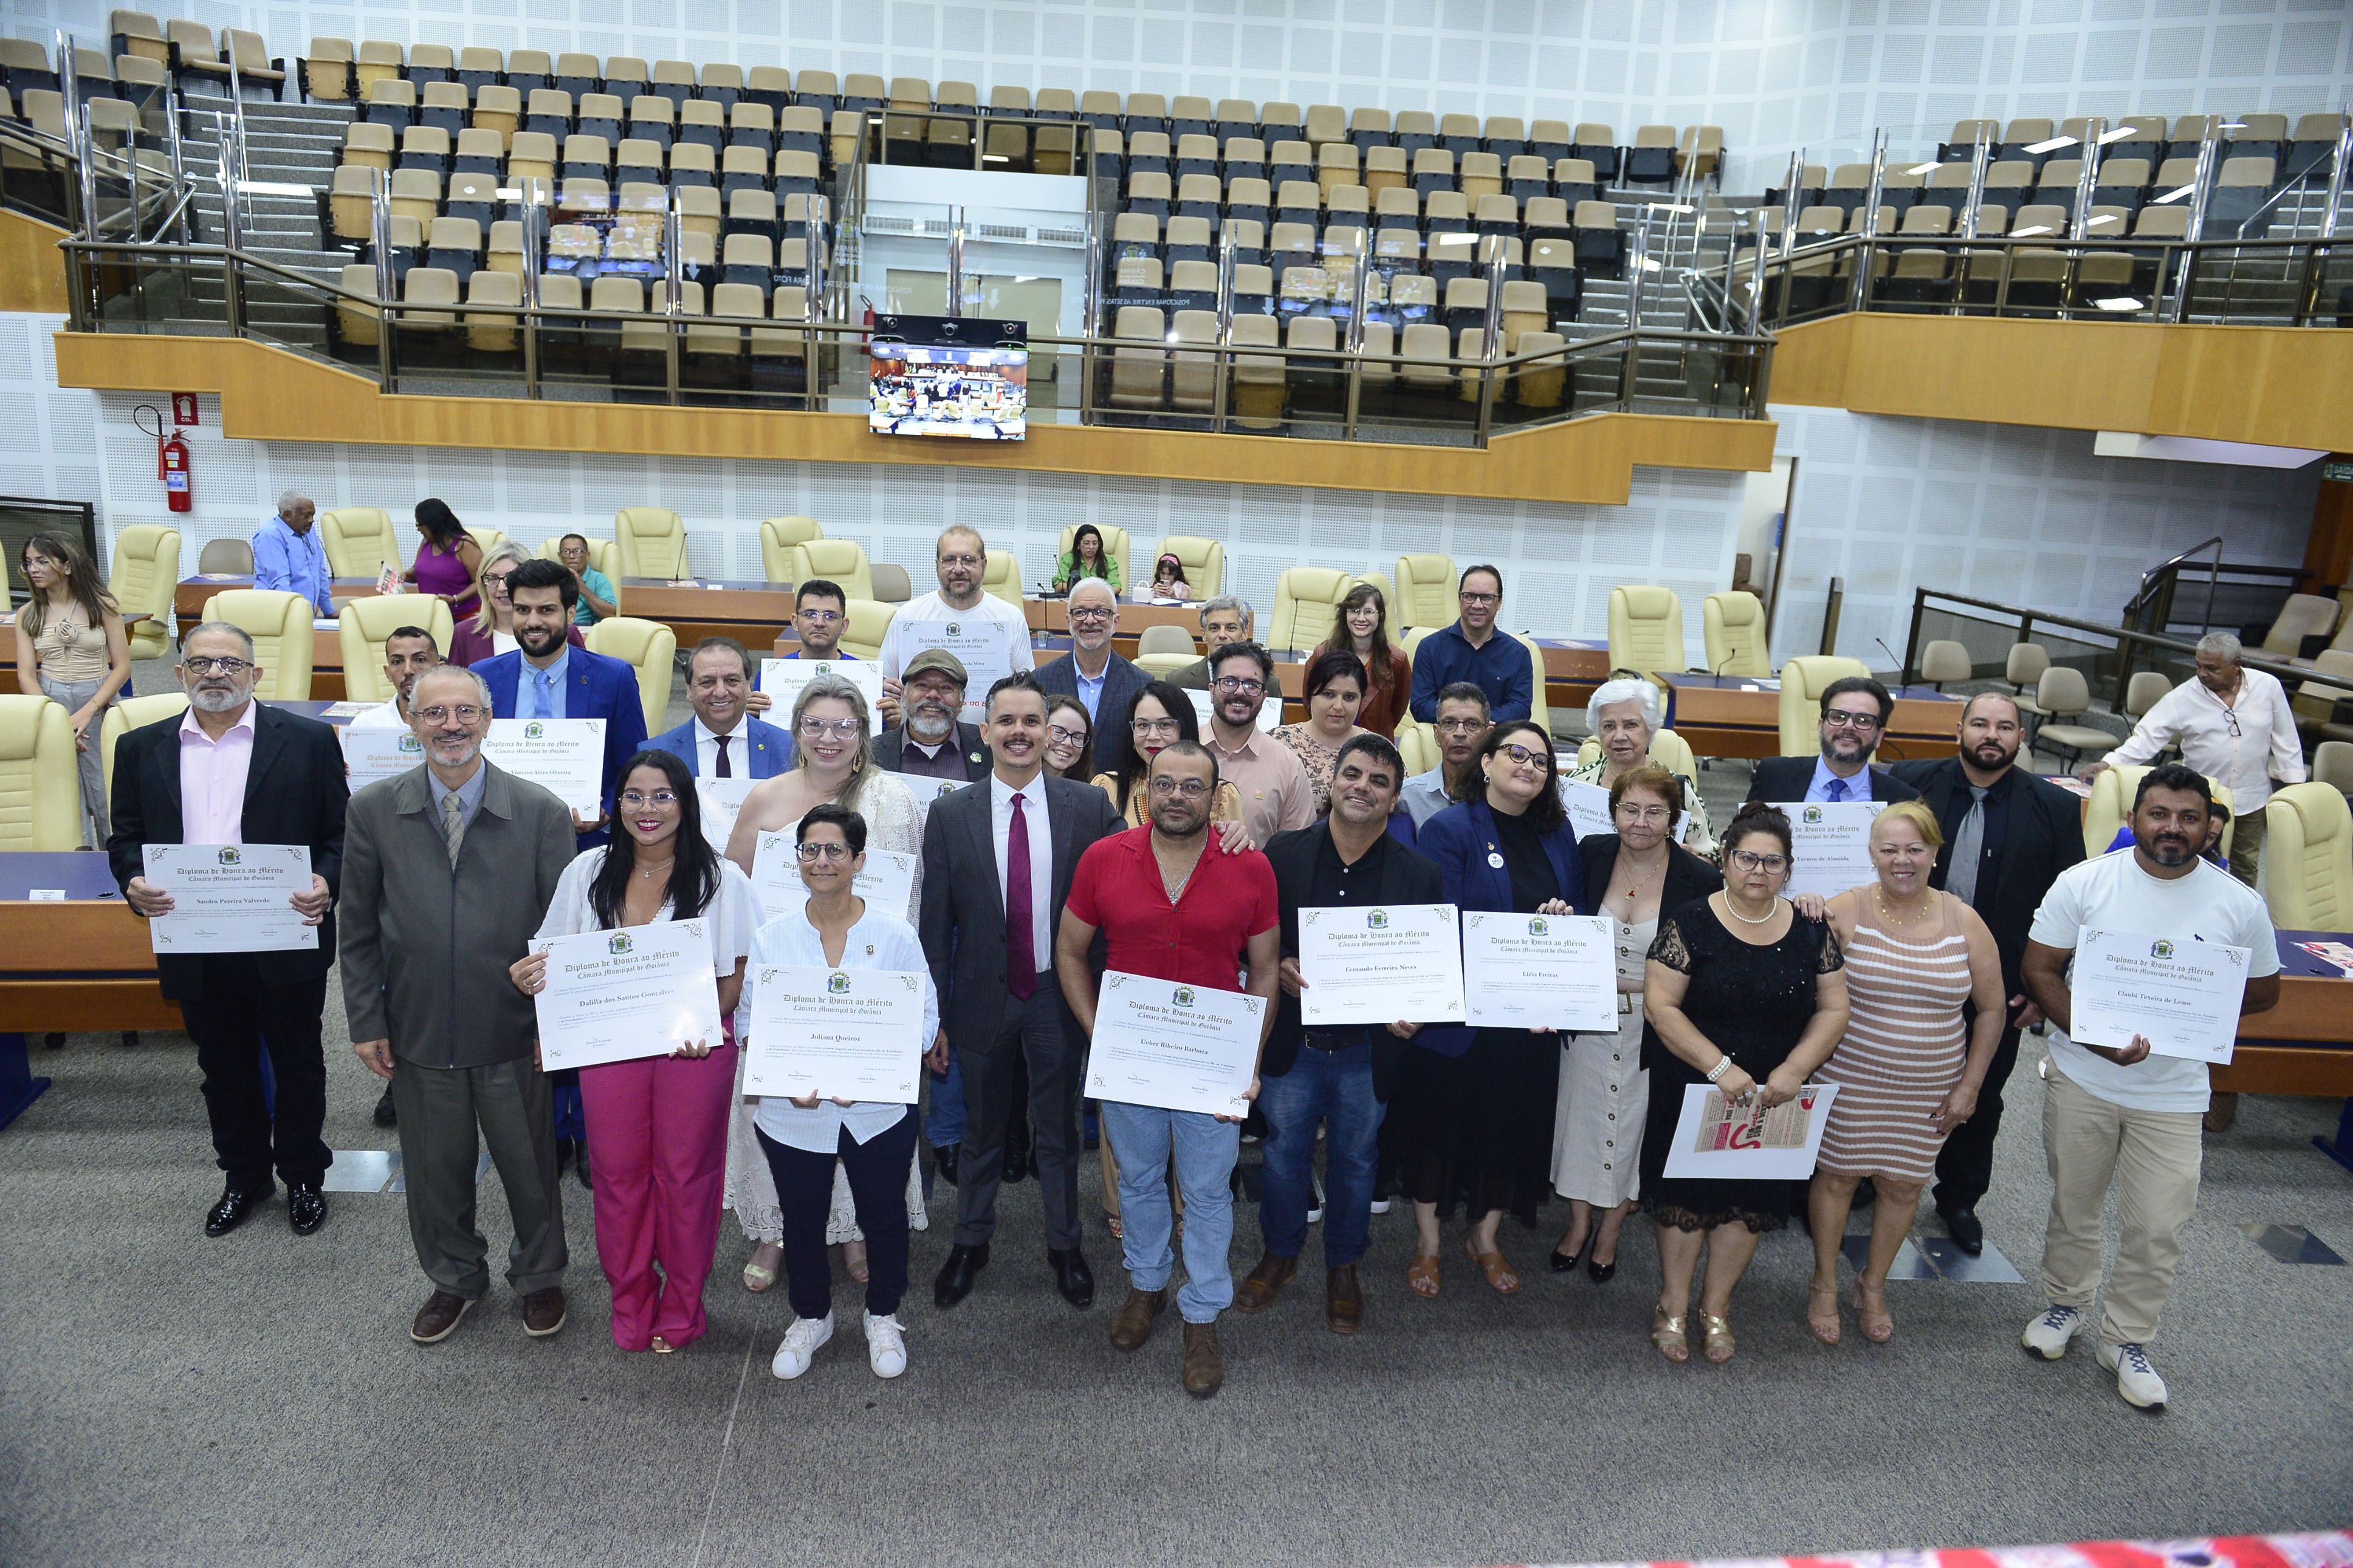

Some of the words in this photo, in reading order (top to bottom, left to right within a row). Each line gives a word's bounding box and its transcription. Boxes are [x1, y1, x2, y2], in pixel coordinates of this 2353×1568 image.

[1573, 804, 1598, 817] Diploma
[1579, 814, 1598, 823] Câmara
[859, 873, 883, 883] Mérito
[565, 962, 600, 973] Diploma
[613, 957, 639, 966] Honra
[653, 950, 680, 960] Mérito
[2106, 954, 2138, 965] Diploma
[2151, 960, 2175, 971] Honra
[2188, 966, 2214, 976] Mérito
[604, 966, 636, 976] Municipal
[2115, 964, 2138, 973] Câmara
[2140, 968, 2169, 978] Municipal
[2178, 973, 2202, 982] Goiânia
[580, 998, 602, 1007] Dalilla
[617, 993, 640, 1002] Santos
[641, 989, 675, 998] Gonçalves
[783, 994, 816, 1004] Diploma
[829, 996, 853, 1005] Honra
[867, 998, 893, 1007] Mérito
[2140, 993, 2163, 1002] Texeira
[2174, 998, 2191, 1007] Lemo
[818, 1005, 849, 1014] Municipal
[1128, 1001, 1159, 1013] Diploma
[1172, 1008, 1195, 1019] Honra
[1207, 1014, 1232, 1025] Mérito
[1137, 1012, 1159, 1021] Câmara
[1161, 1016, 1190, 1026] Municipal
[1198, 1021, 1221, 1031] Goiânia
[1141, 1039, 1159, 1048] Ueber
[1160, 1041, 1183, 1051] Ribeiro
[1184, 1044, 1209, 1055] Barboza
